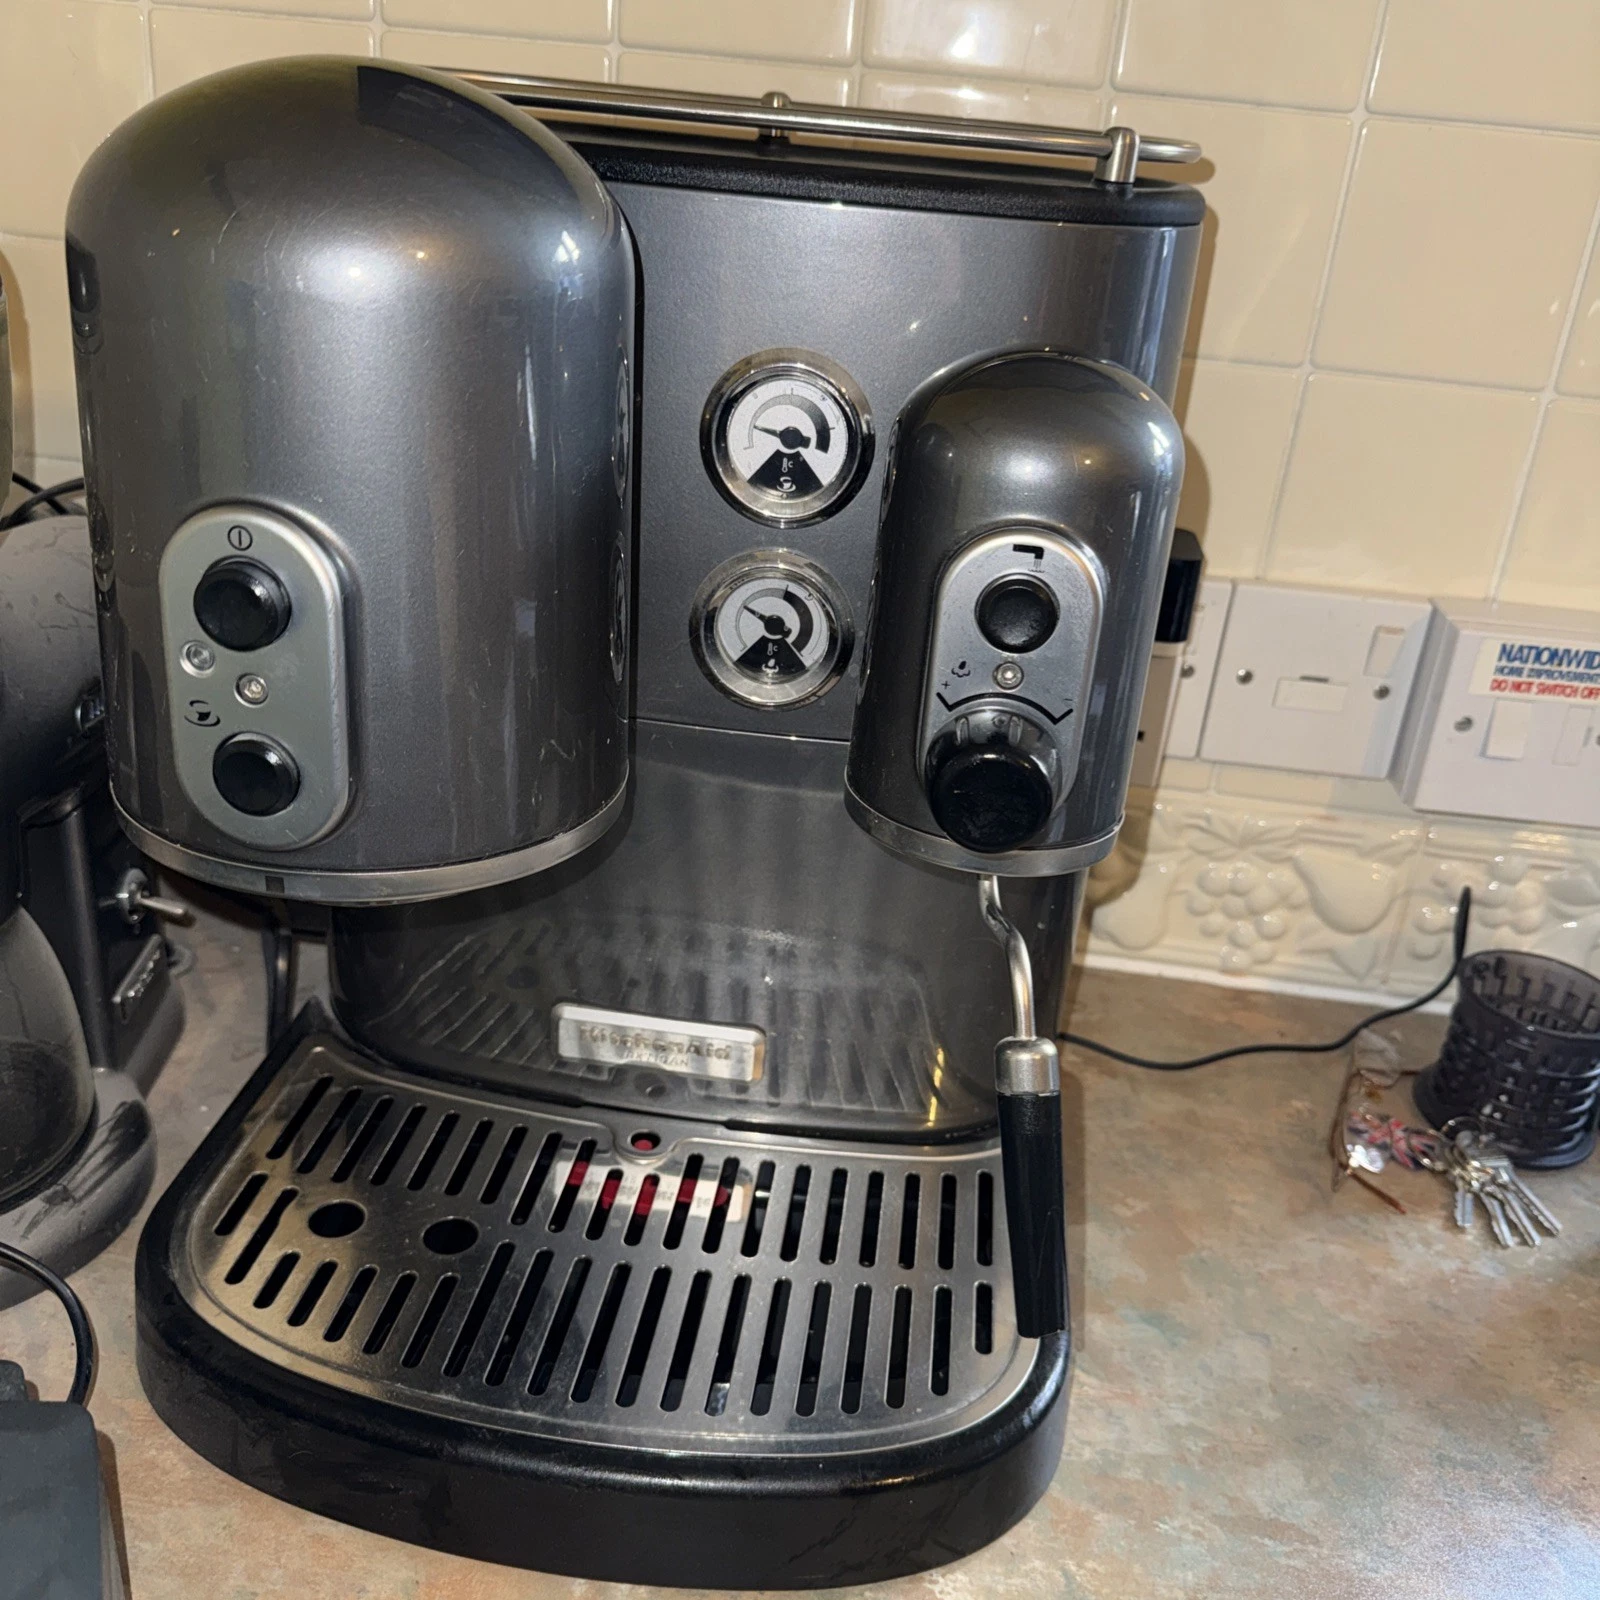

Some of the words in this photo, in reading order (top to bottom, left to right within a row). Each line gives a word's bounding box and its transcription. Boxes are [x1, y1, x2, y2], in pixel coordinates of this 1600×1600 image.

[1494, 665, 1525, 678] HOME
[1490, 679, 1508, 692] DO
[1509, 680, 1535, 694] NOT
[1535, 682, 1579, 698] SWITCH
